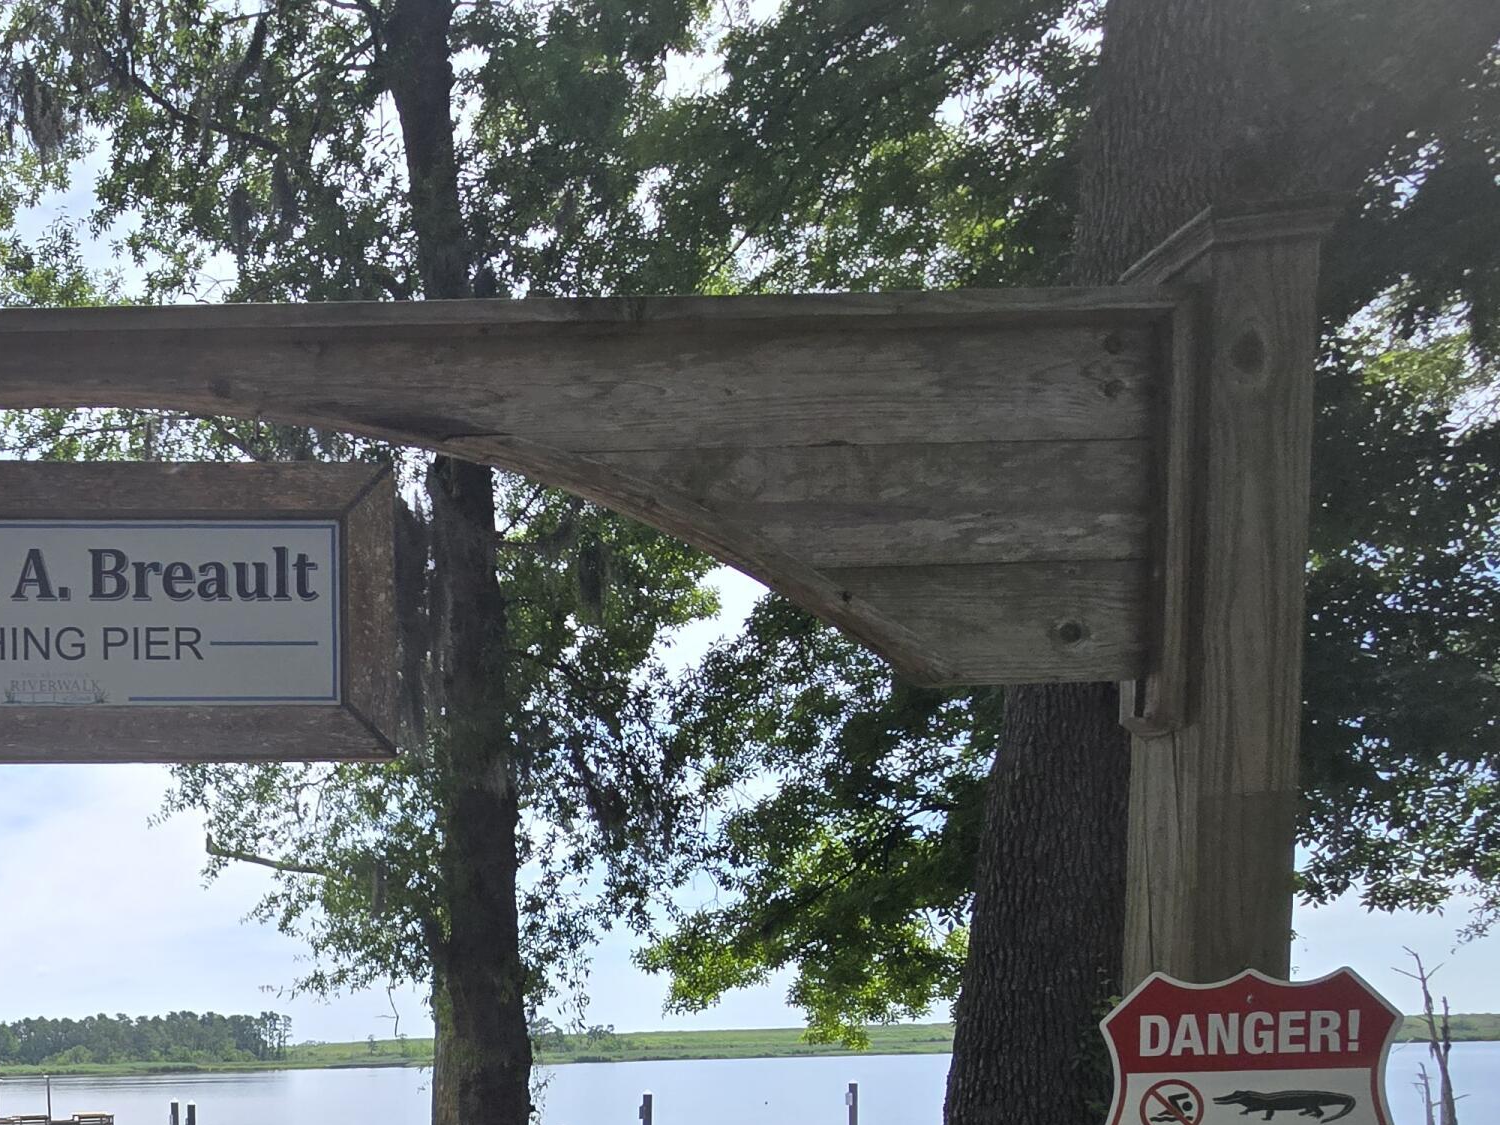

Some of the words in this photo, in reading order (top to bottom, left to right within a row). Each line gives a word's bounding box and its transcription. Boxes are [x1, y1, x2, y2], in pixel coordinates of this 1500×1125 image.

[11, 547, 72, 601] A.
[88, 546, 320, 601] Breault
[102, 626, 204, 661] PIER
[10, 679, 102, 692] RIVERWALK
[1139, 1009, 1361, 1058] DANGER!
